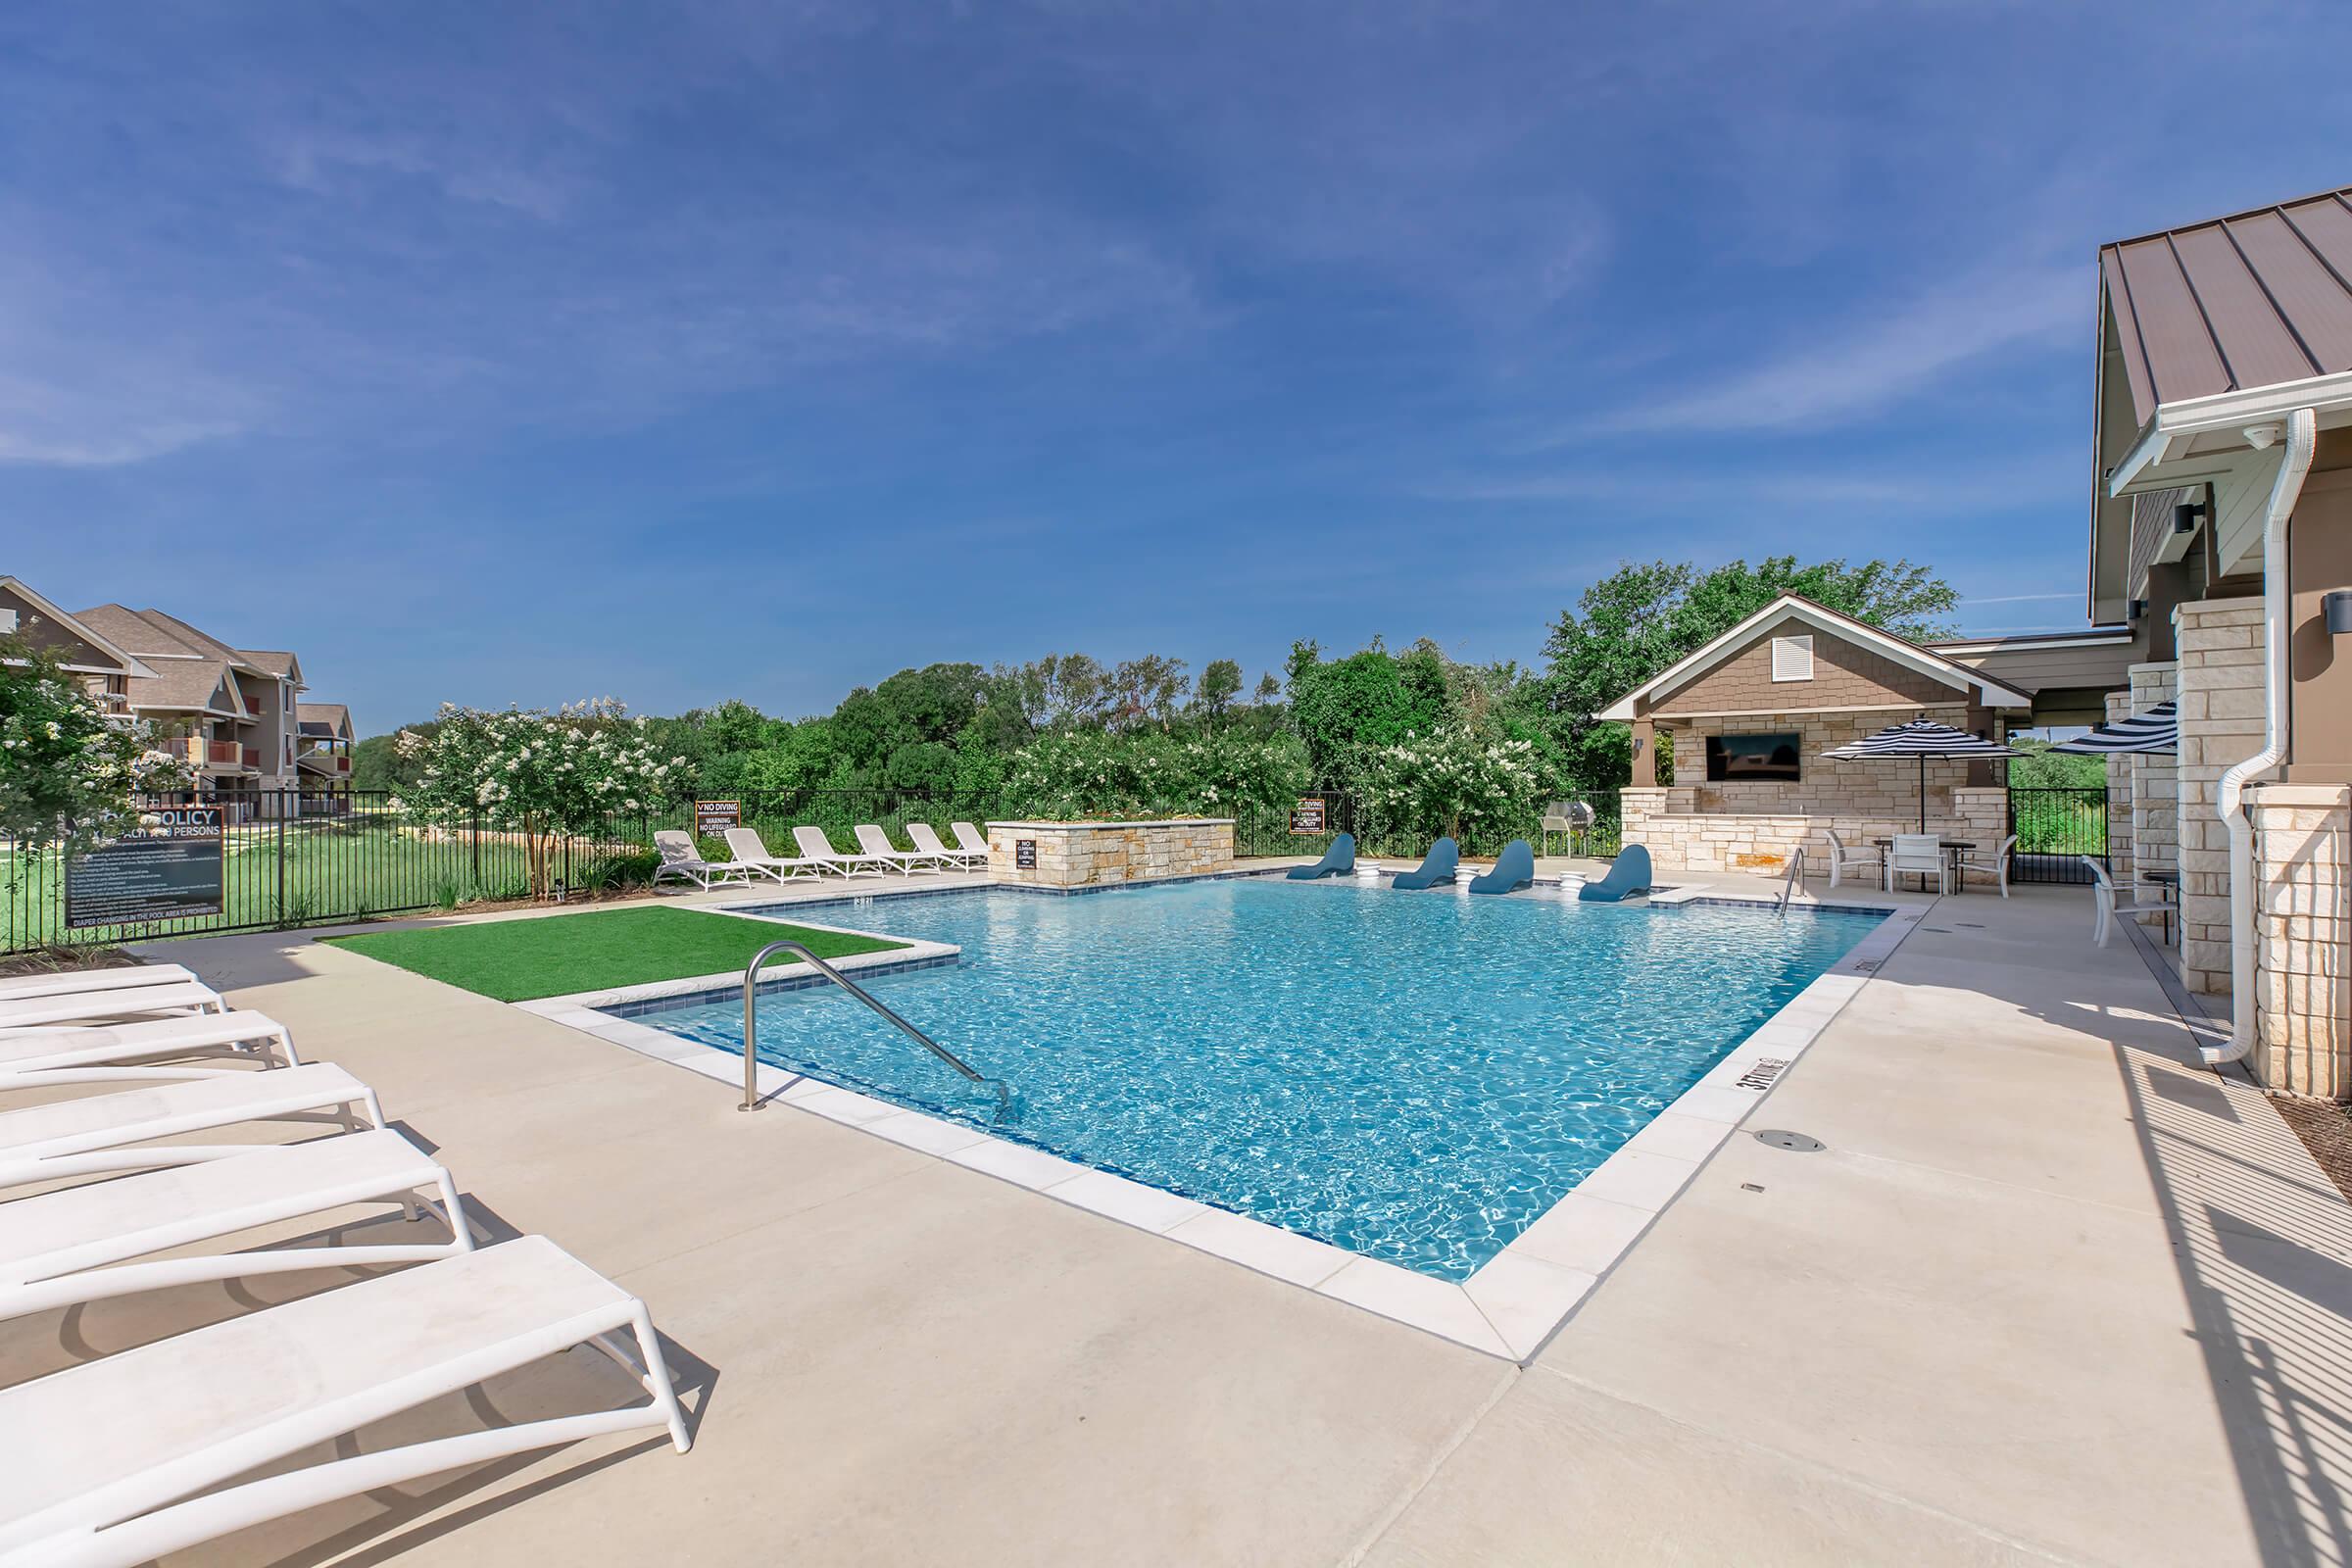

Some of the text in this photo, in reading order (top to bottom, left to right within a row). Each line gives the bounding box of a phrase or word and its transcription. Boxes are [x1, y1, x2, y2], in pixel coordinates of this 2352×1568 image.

[173, 826, 220, 836] PERSONS
[74, 917, 96, 927] DIAPER
[97, 914, 125, 925] CHANGING
[134, 912, 148, 921] THE
[148, 911, 166, 920] POOL
[166, 909, 180, 918] AREA
[186, 906, 219, 915] PROHIBITED
